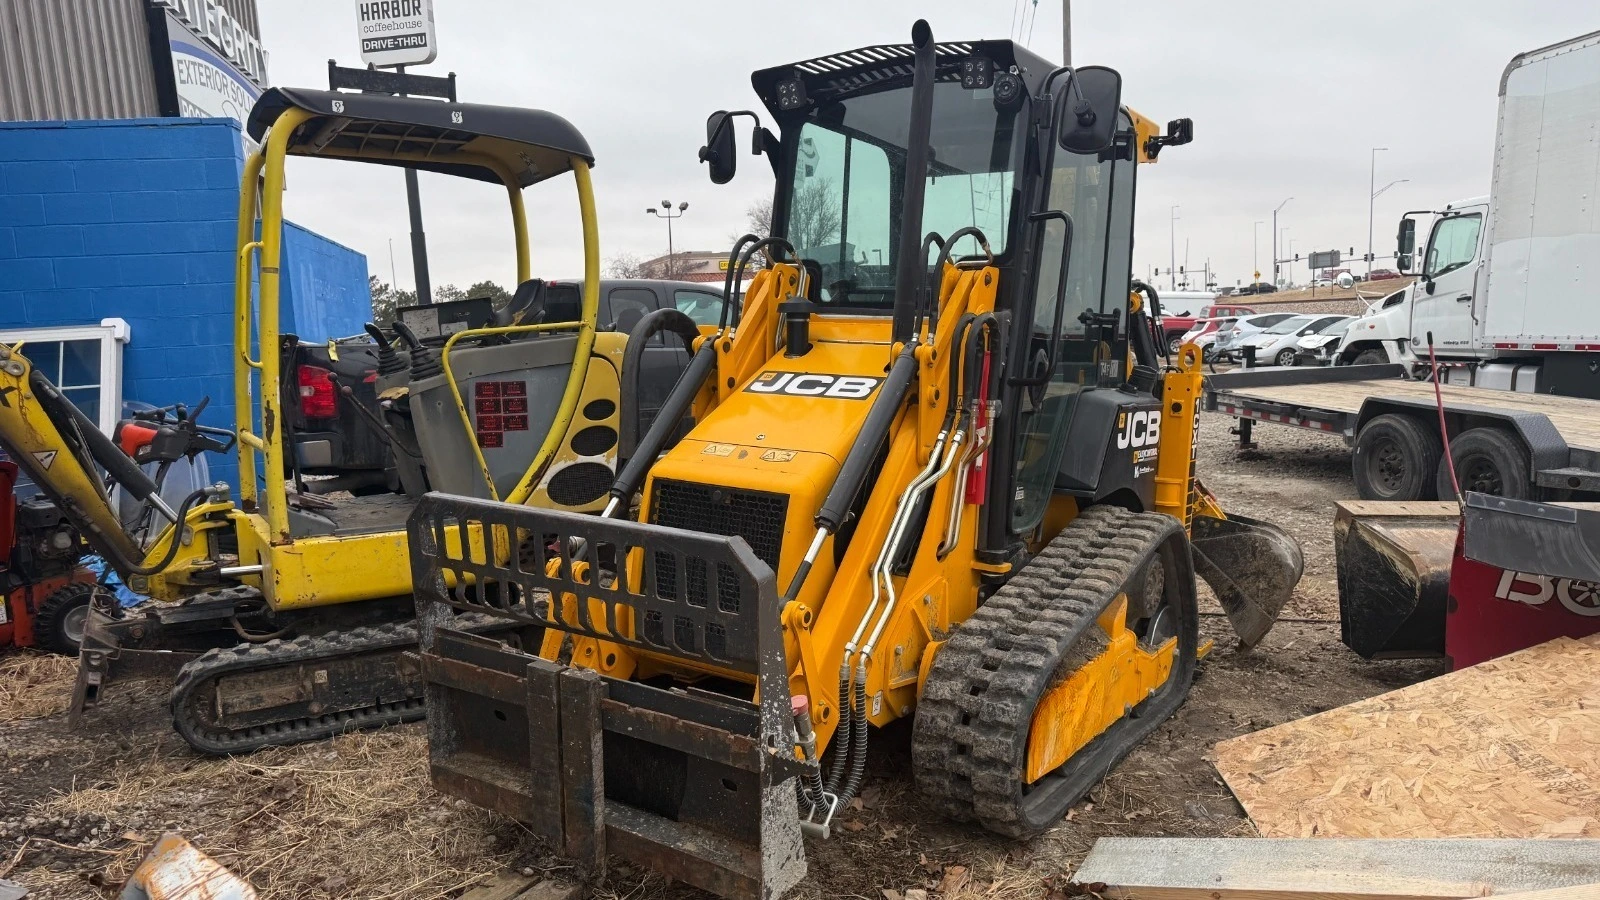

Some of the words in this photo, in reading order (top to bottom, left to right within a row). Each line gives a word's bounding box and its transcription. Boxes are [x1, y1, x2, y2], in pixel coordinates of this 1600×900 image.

[360, 0, 422, 21] HARBOR
[363, 20, 423, 33] coffeehouse
[363, 35, 425, 51] DRIVE-THRU
[177, 59, 230, 98] EXTERIOR
[749, 372, 878, 399] JCB
[1117, 410, 1162, 450] JCB
